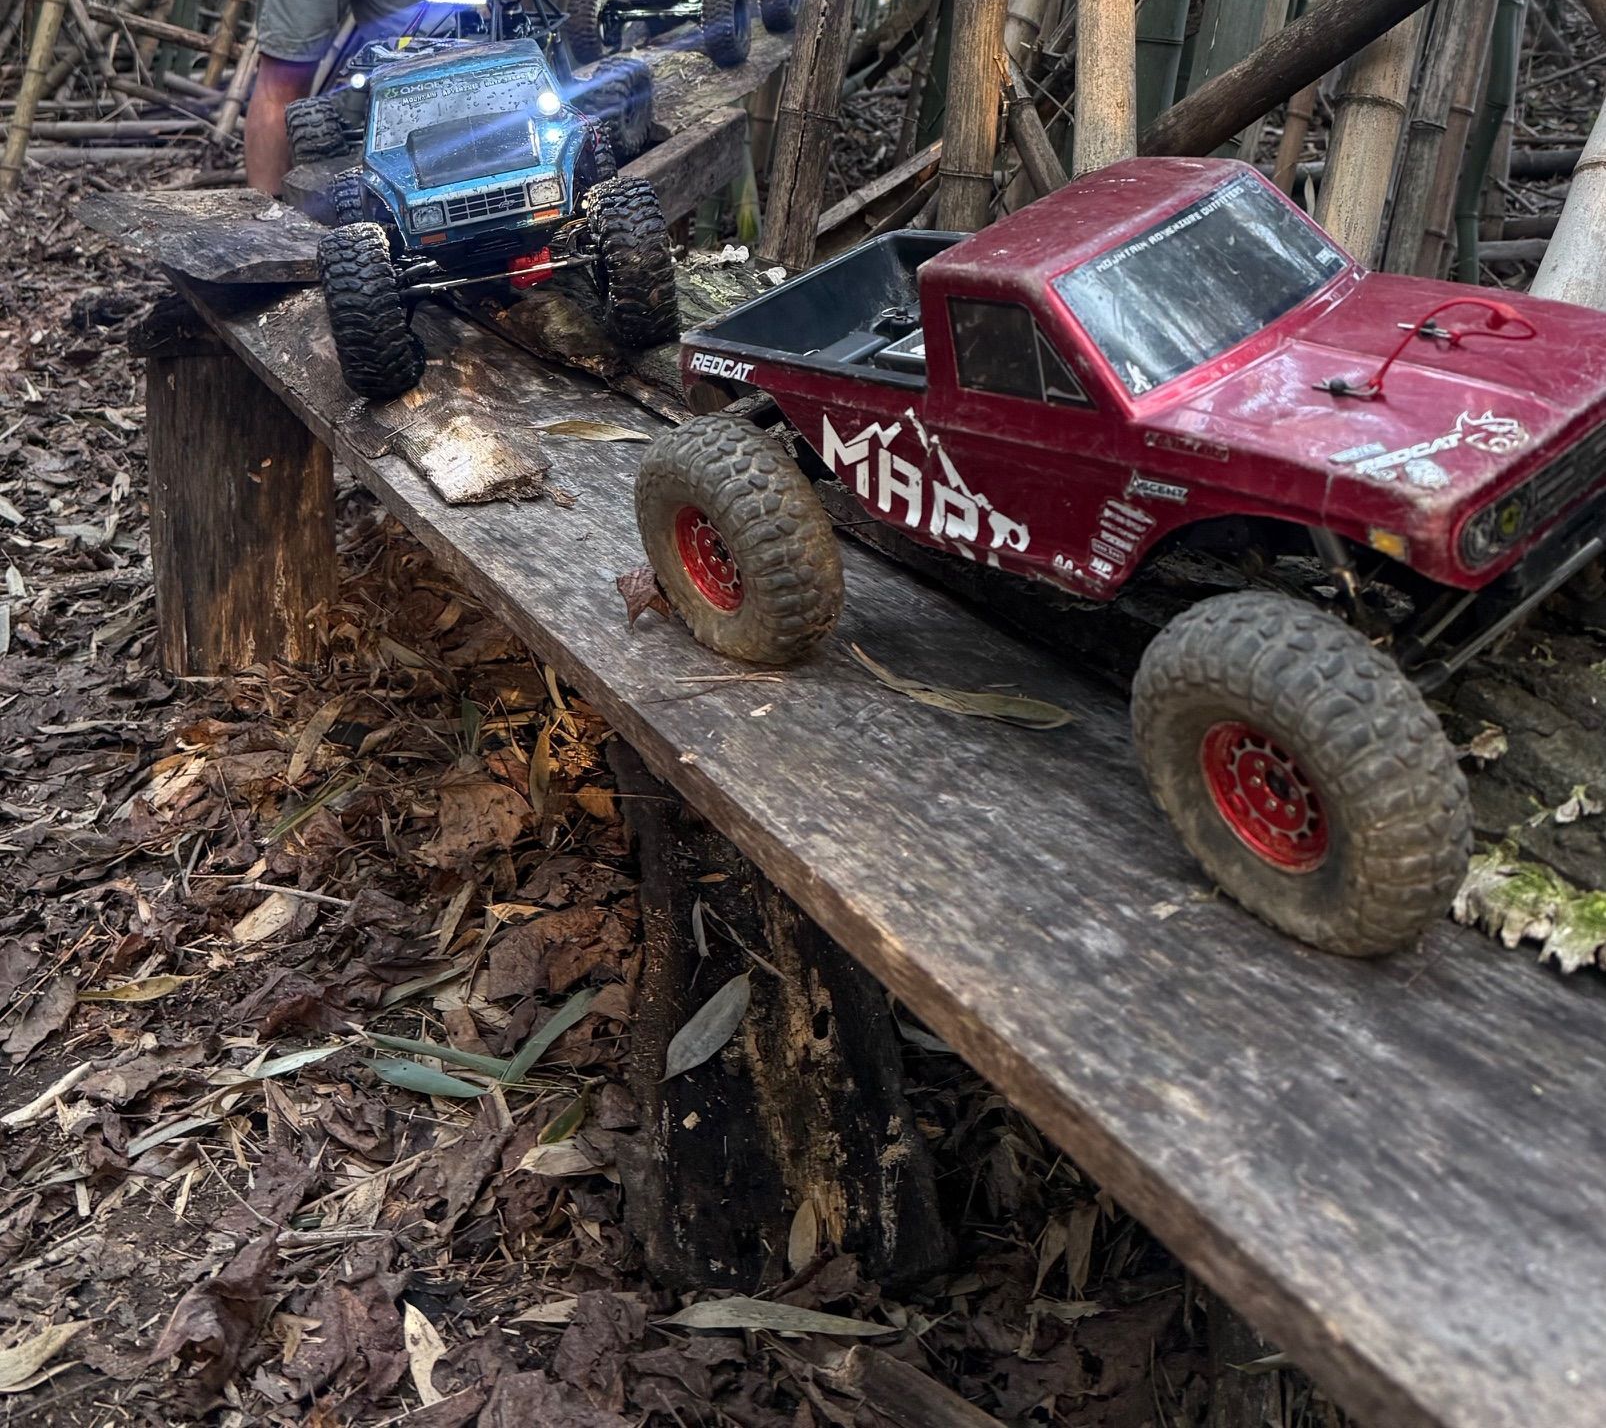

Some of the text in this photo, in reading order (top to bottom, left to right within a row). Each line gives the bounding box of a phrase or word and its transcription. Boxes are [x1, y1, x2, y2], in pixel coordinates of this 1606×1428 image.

[1096, 241, 1149, 272] MOUNTAIN
[1200, 186, 1245, 216] OUTFITTERS
[690, 352, 755, 382] REDCAT
